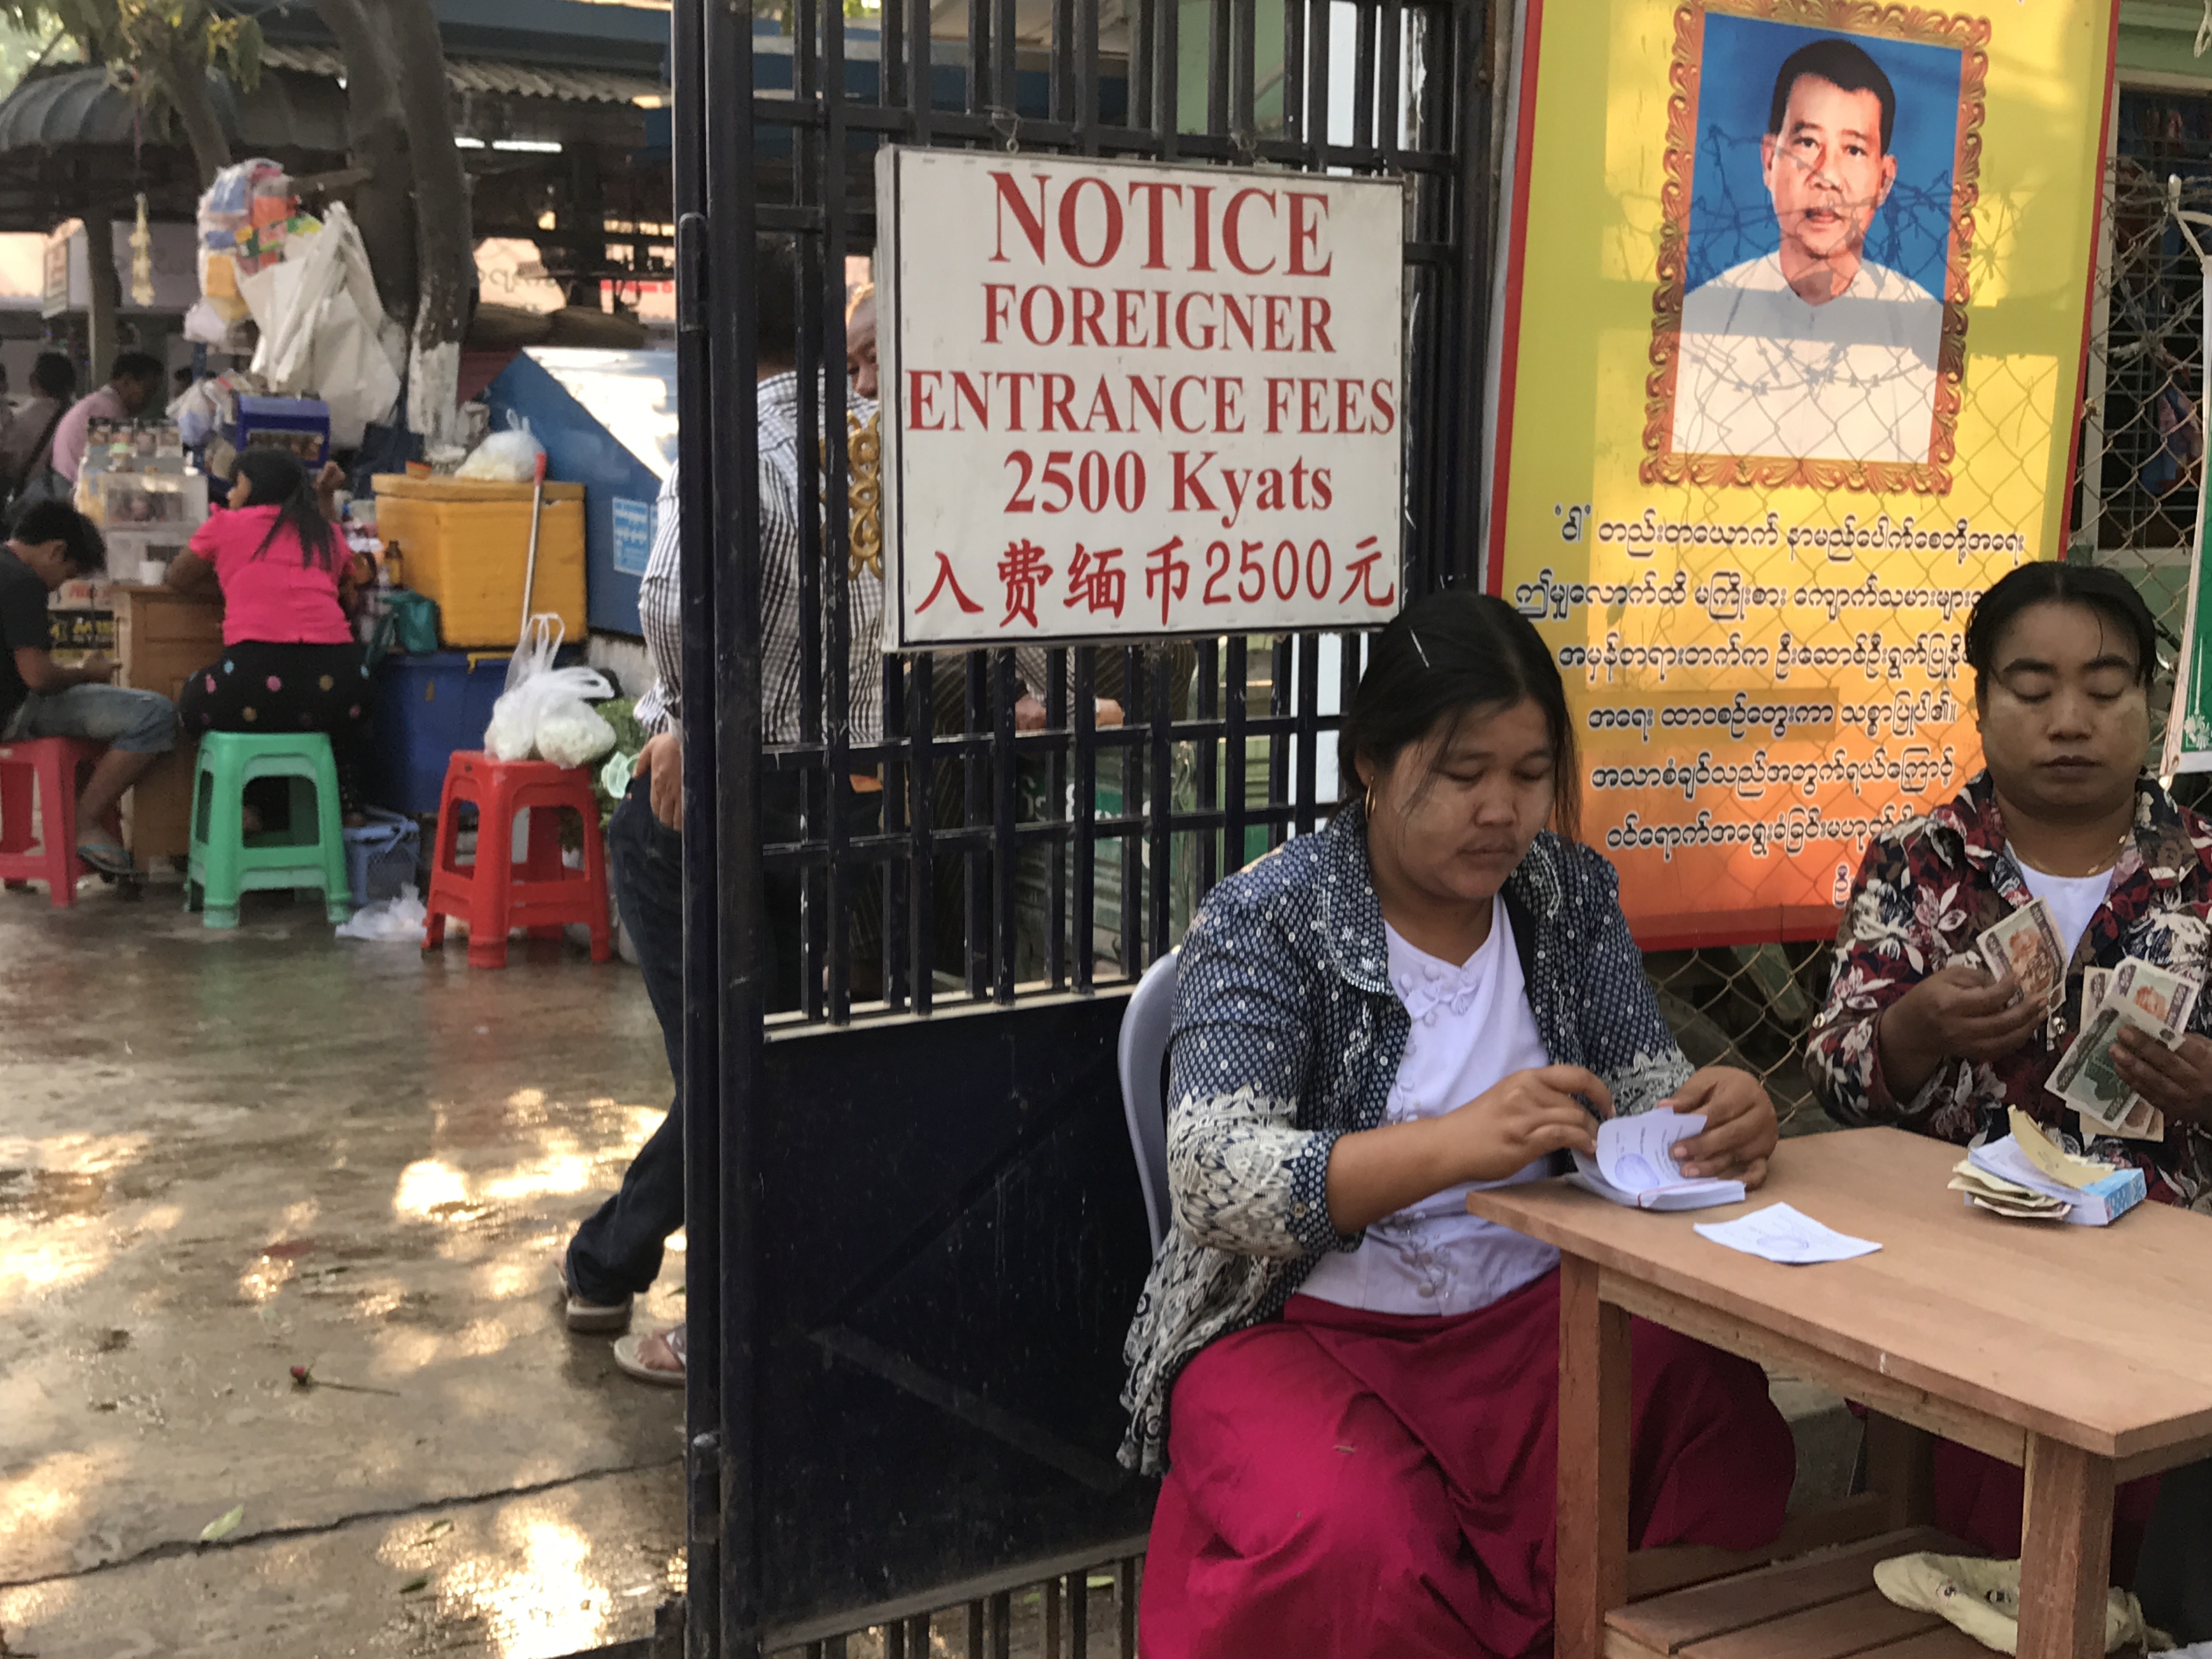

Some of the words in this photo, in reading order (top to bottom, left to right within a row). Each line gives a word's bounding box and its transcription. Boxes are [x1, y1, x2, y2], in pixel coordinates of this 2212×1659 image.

[986, 171, 1333, 277] NOTICE
[981, 282, 1336, 353] FOREIGNER
[905, 369, 1245, 433] ENTRANCE
[1263, 377, 1396, 435] FEES
[1003, 450, 1147, 514] 2500
[1168, 450, 1333, 528] Kyats
[914, 535, 1396, 629] 入费缅币2500元
